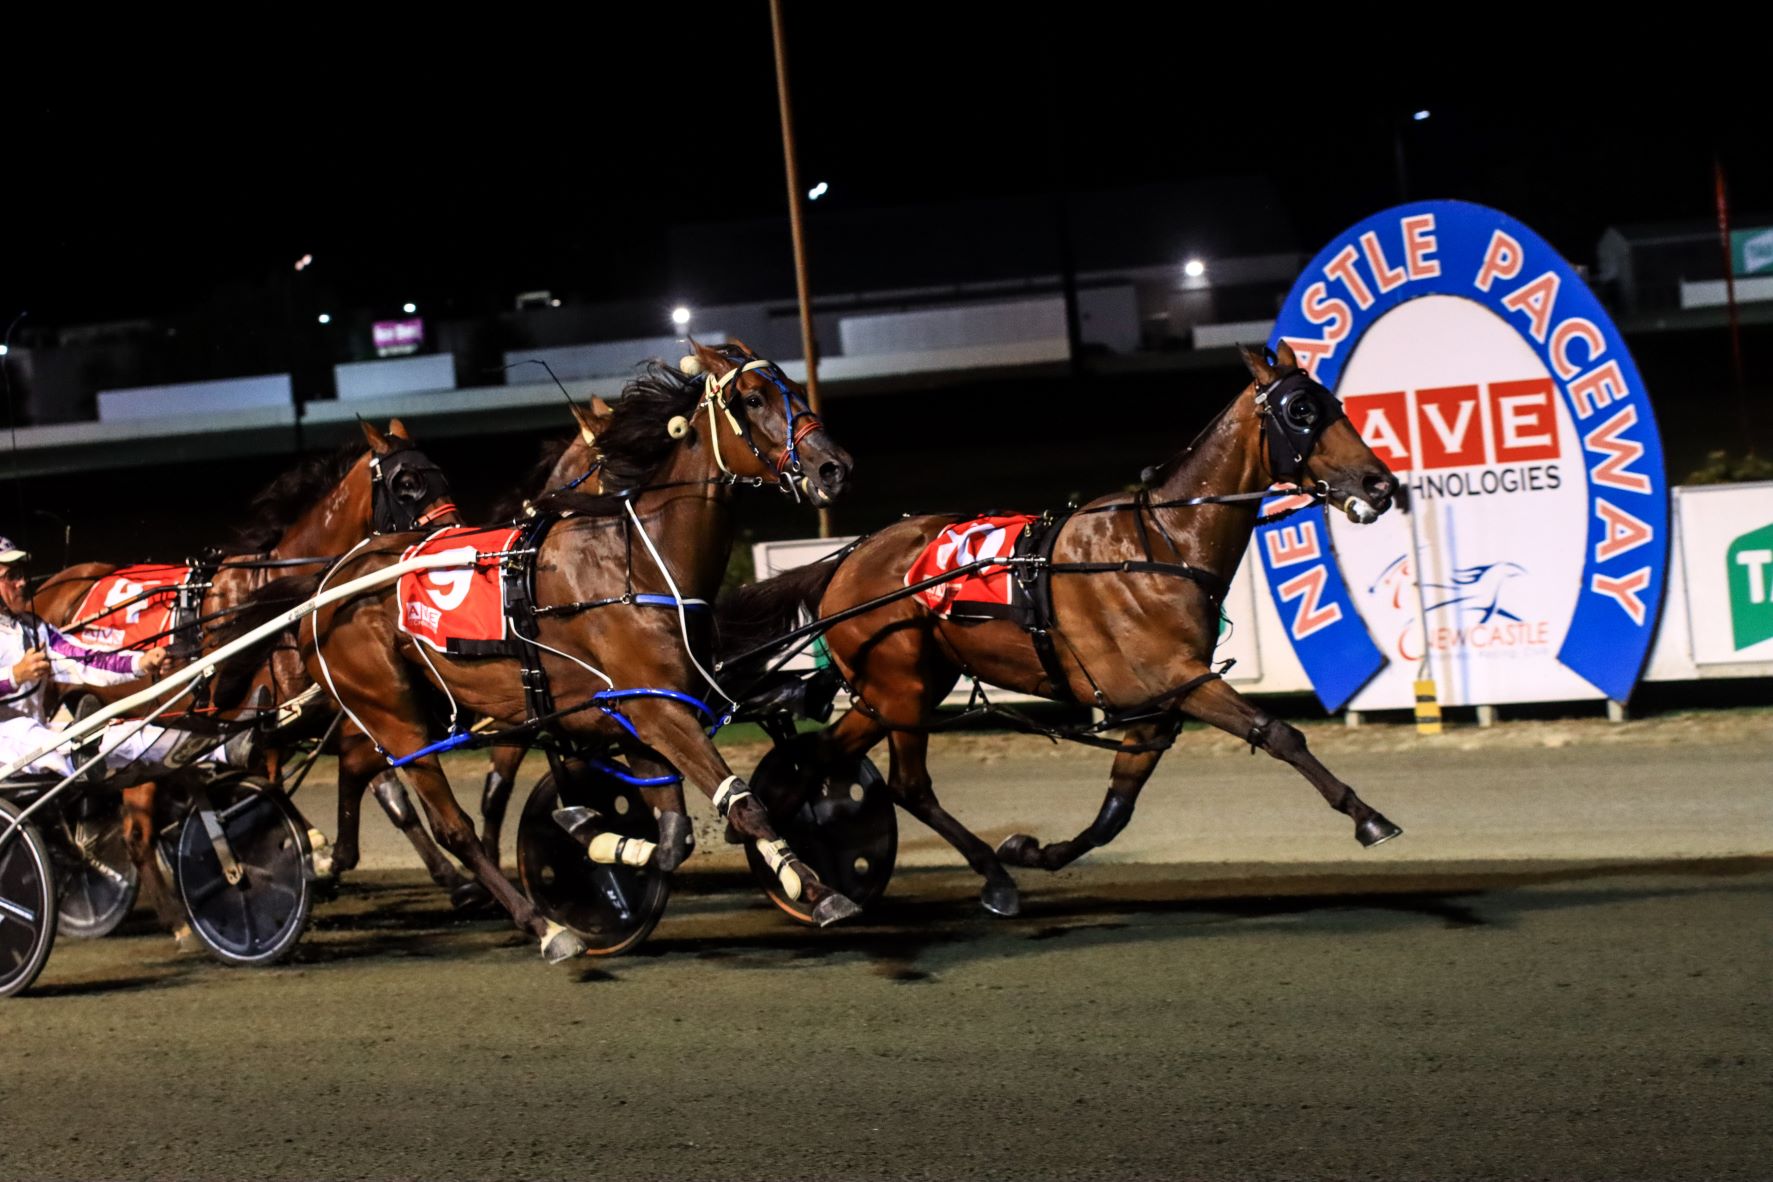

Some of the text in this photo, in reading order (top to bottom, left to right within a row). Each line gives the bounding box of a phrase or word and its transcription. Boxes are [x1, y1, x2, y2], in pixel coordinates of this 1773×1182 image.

[1361, 392, 1552, 458] AVE
[1474, 229, 1653, 626] PACEWAY
[1411, 465, 1561, 499] HNOLOGIES
[104, 578, 148, 624] 4
[426, 545, 478, 611] 9
[1736, 549, 1773, 604] T
